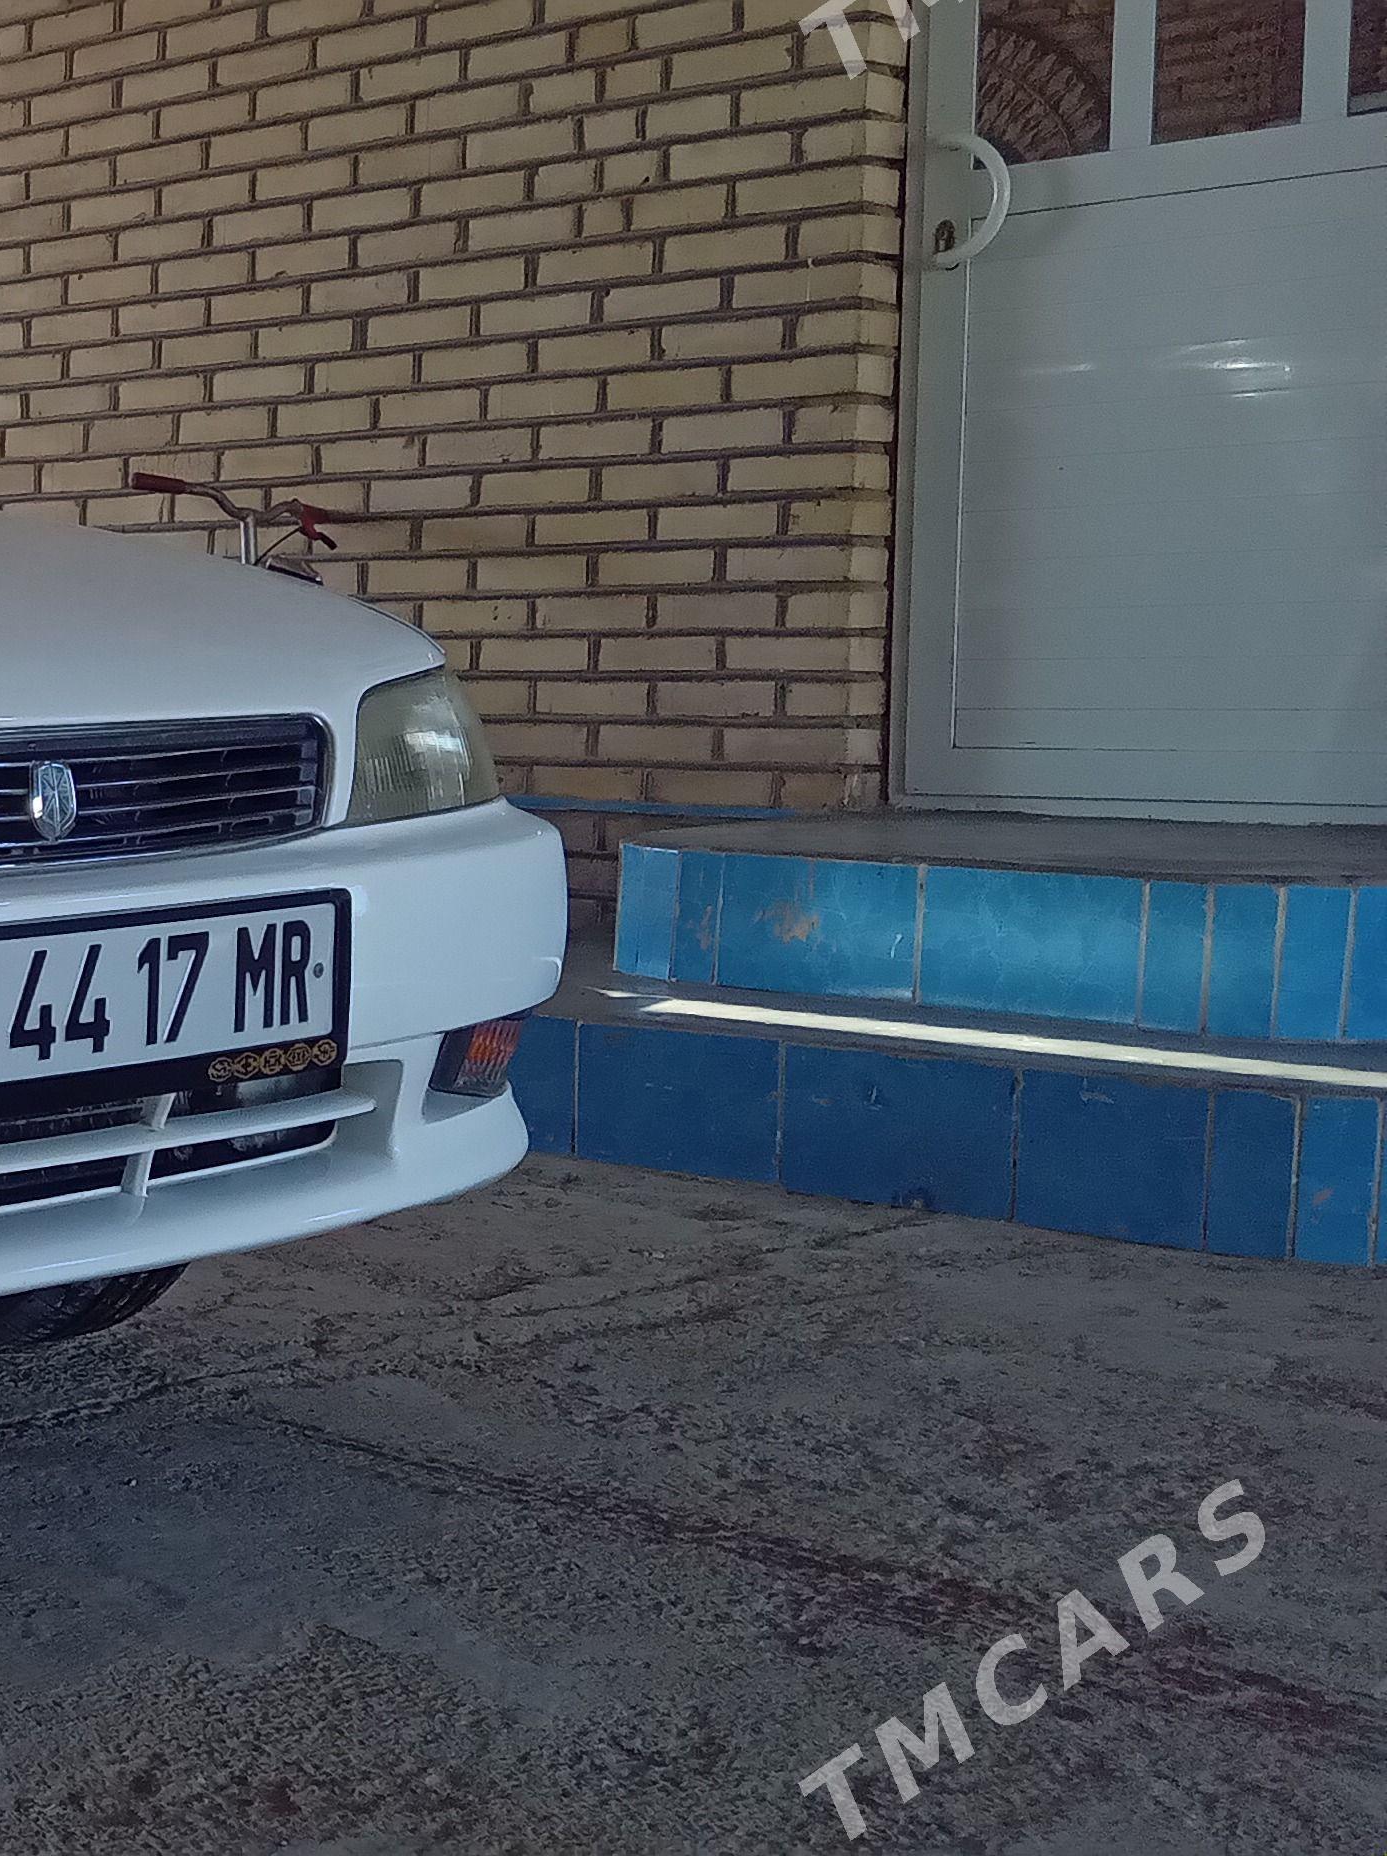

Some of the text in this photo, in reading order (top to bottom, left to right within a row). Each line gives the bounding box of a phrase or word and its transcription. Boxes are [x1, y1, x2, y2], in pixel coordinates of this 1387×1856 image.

[9, 944, 111, 1061] 44
[137, 930, 211, 1047] 17
[233, 919, 312, 1034] MR
